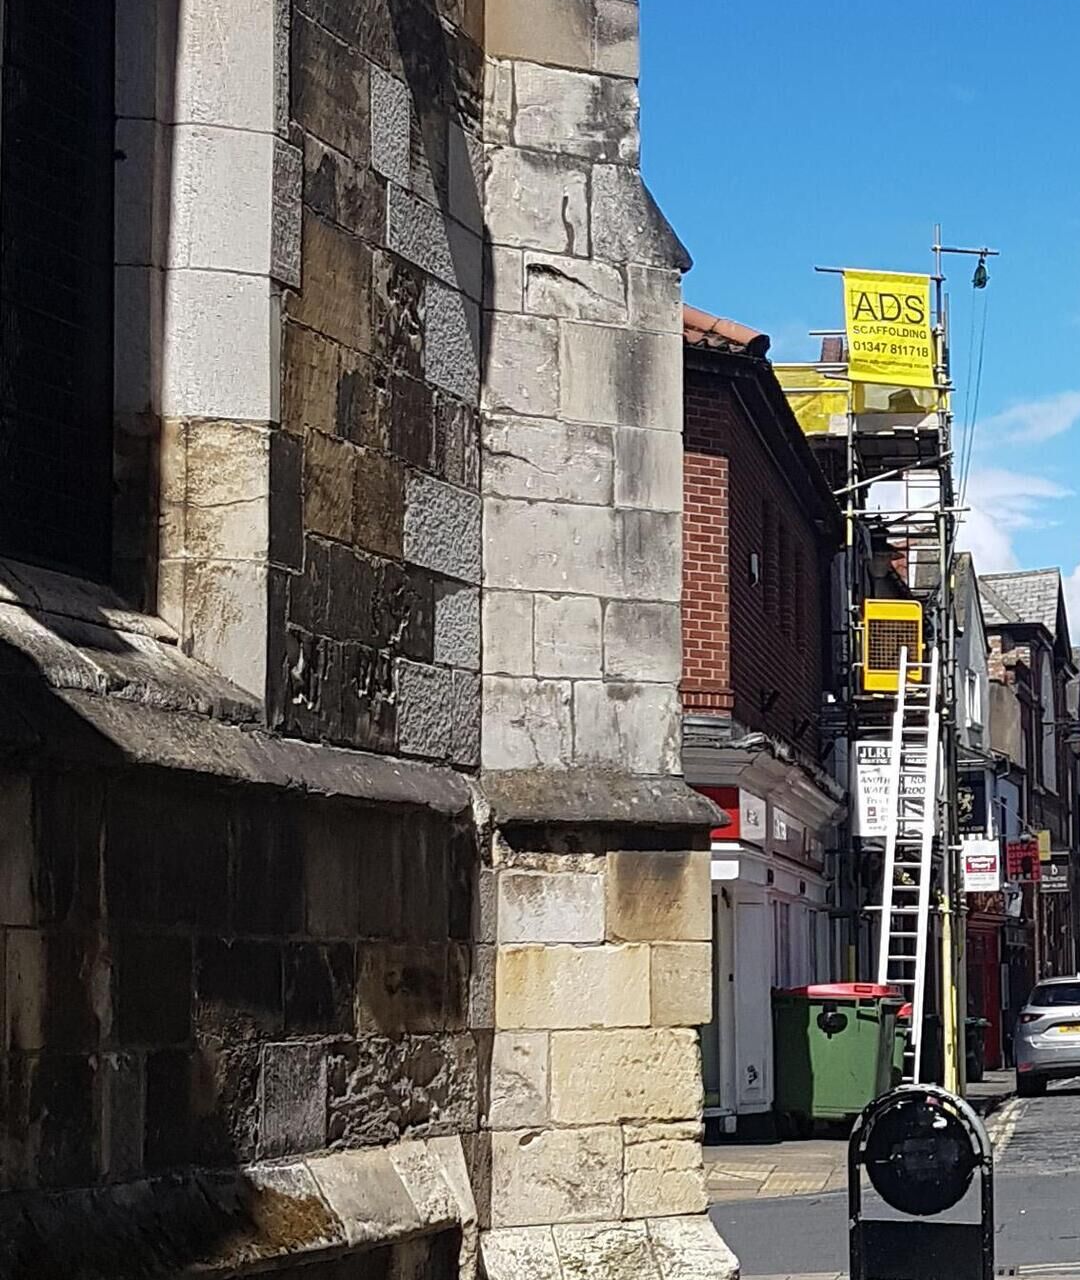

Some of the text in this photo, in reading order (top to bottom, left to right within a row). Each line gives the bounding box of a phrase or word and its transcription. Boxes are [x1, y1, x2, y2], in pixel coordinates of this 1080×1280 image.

[853, 291, 925, 325] ADS
[852, 324, 928, 340] SCAFFOLDING
[853, 340, 929, 358] 01347 811718
